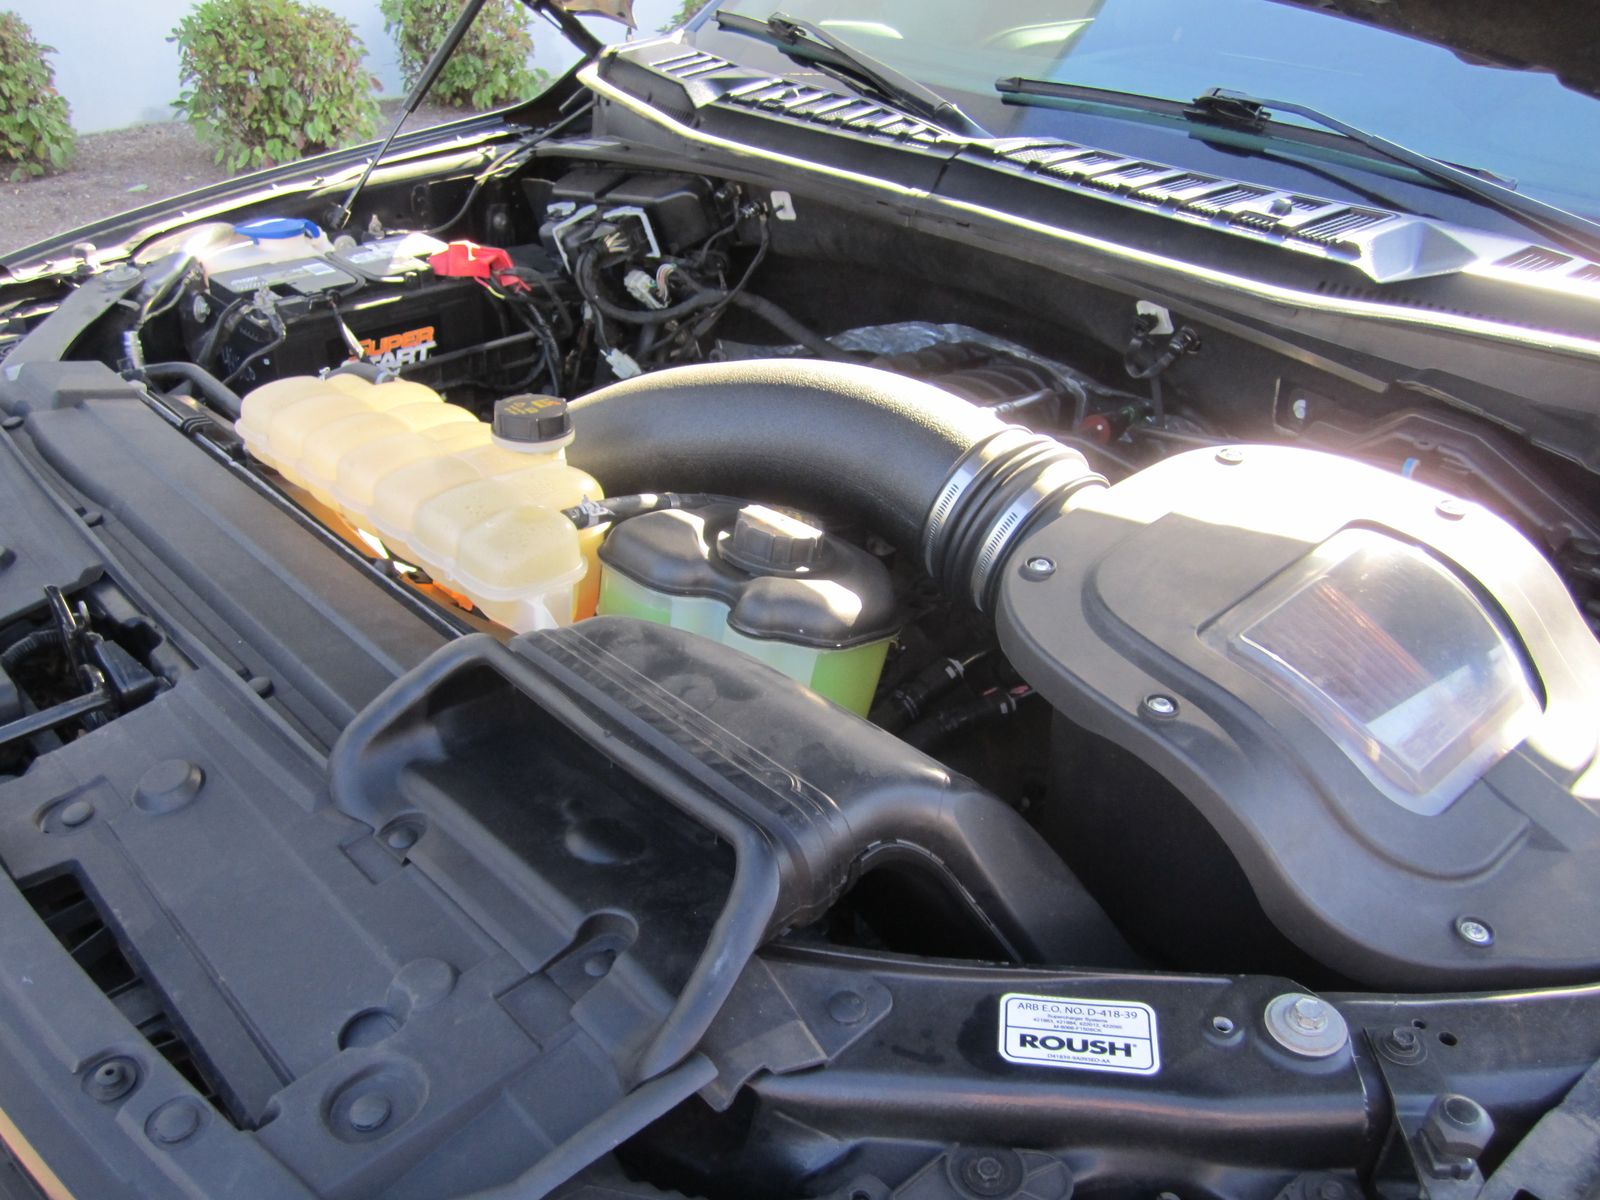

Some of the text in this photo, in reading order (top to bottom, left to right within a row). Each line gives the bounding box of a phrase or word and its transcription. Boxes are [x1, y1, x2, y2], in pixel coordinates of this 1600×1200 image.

[369, 340, 438, 369] TART
[1017, 1002, 1138, 1020] ARB E.O. NO. D-418-39
[1019, 1033, 1132, 1057] ROUSH
